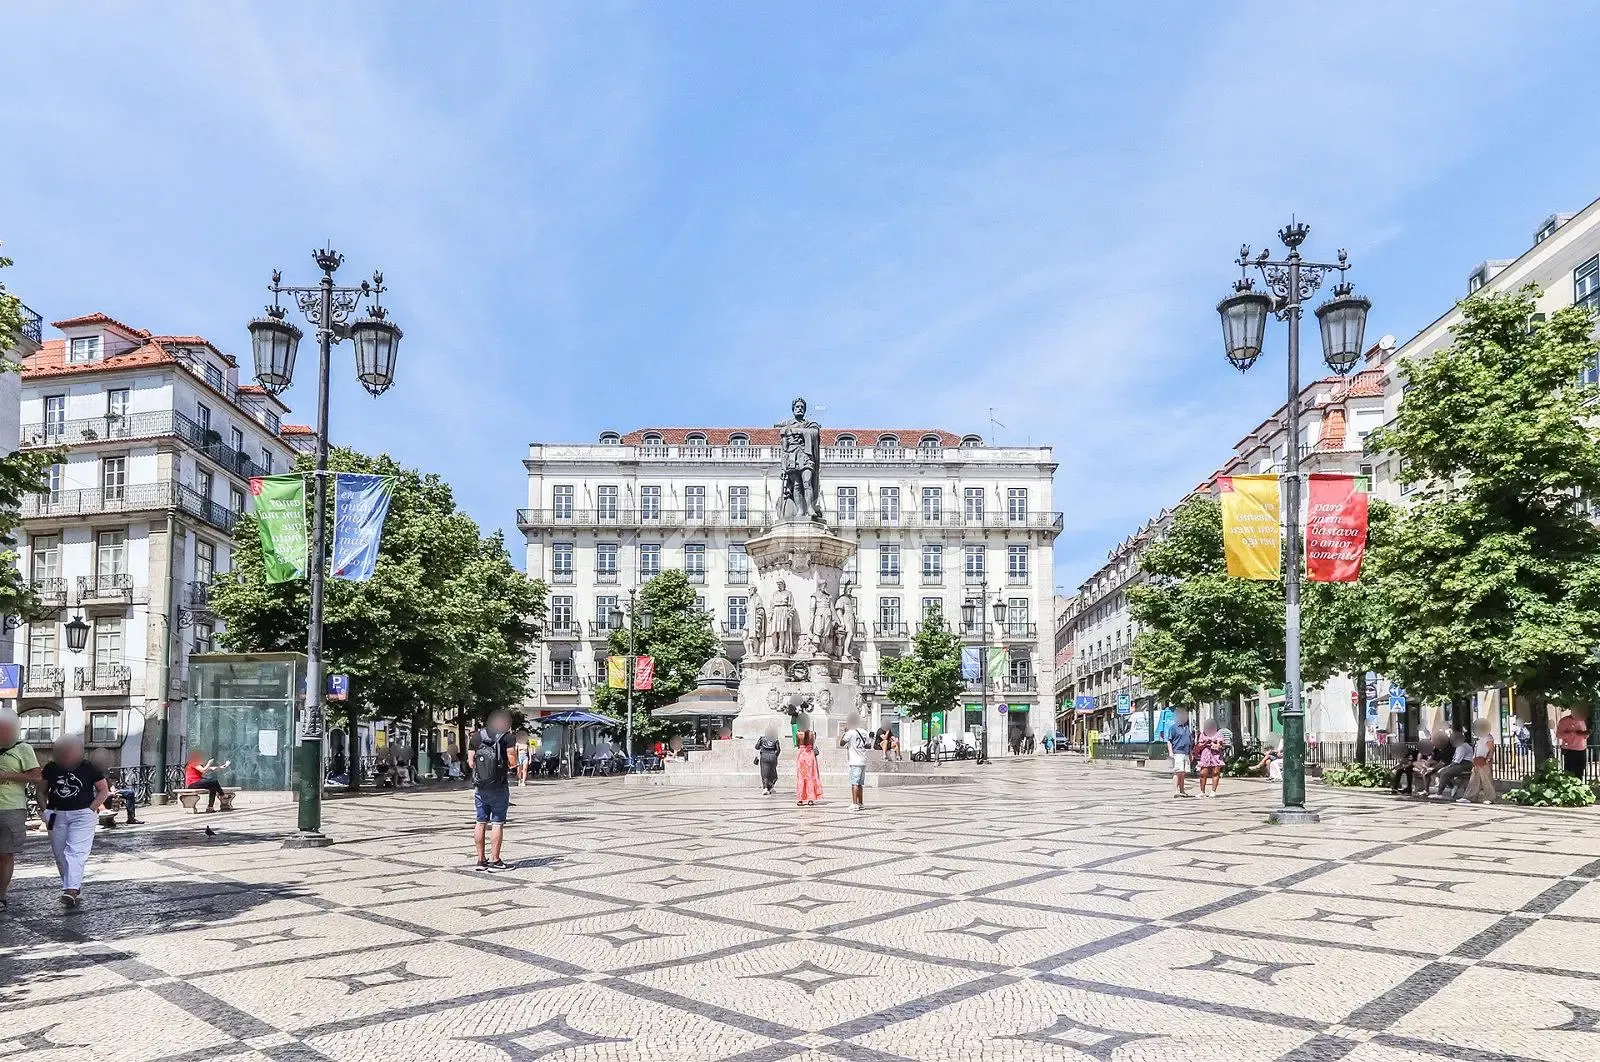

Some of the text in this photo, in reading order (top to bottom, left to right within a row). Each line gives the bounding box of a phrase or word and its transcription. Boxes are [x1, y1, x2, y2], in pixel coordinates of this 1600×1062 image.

[1311, 524, 1360, 537] bastava
[1310, 539, 1353, 549] o amor
[1309, 551, 1357, 561] somente
